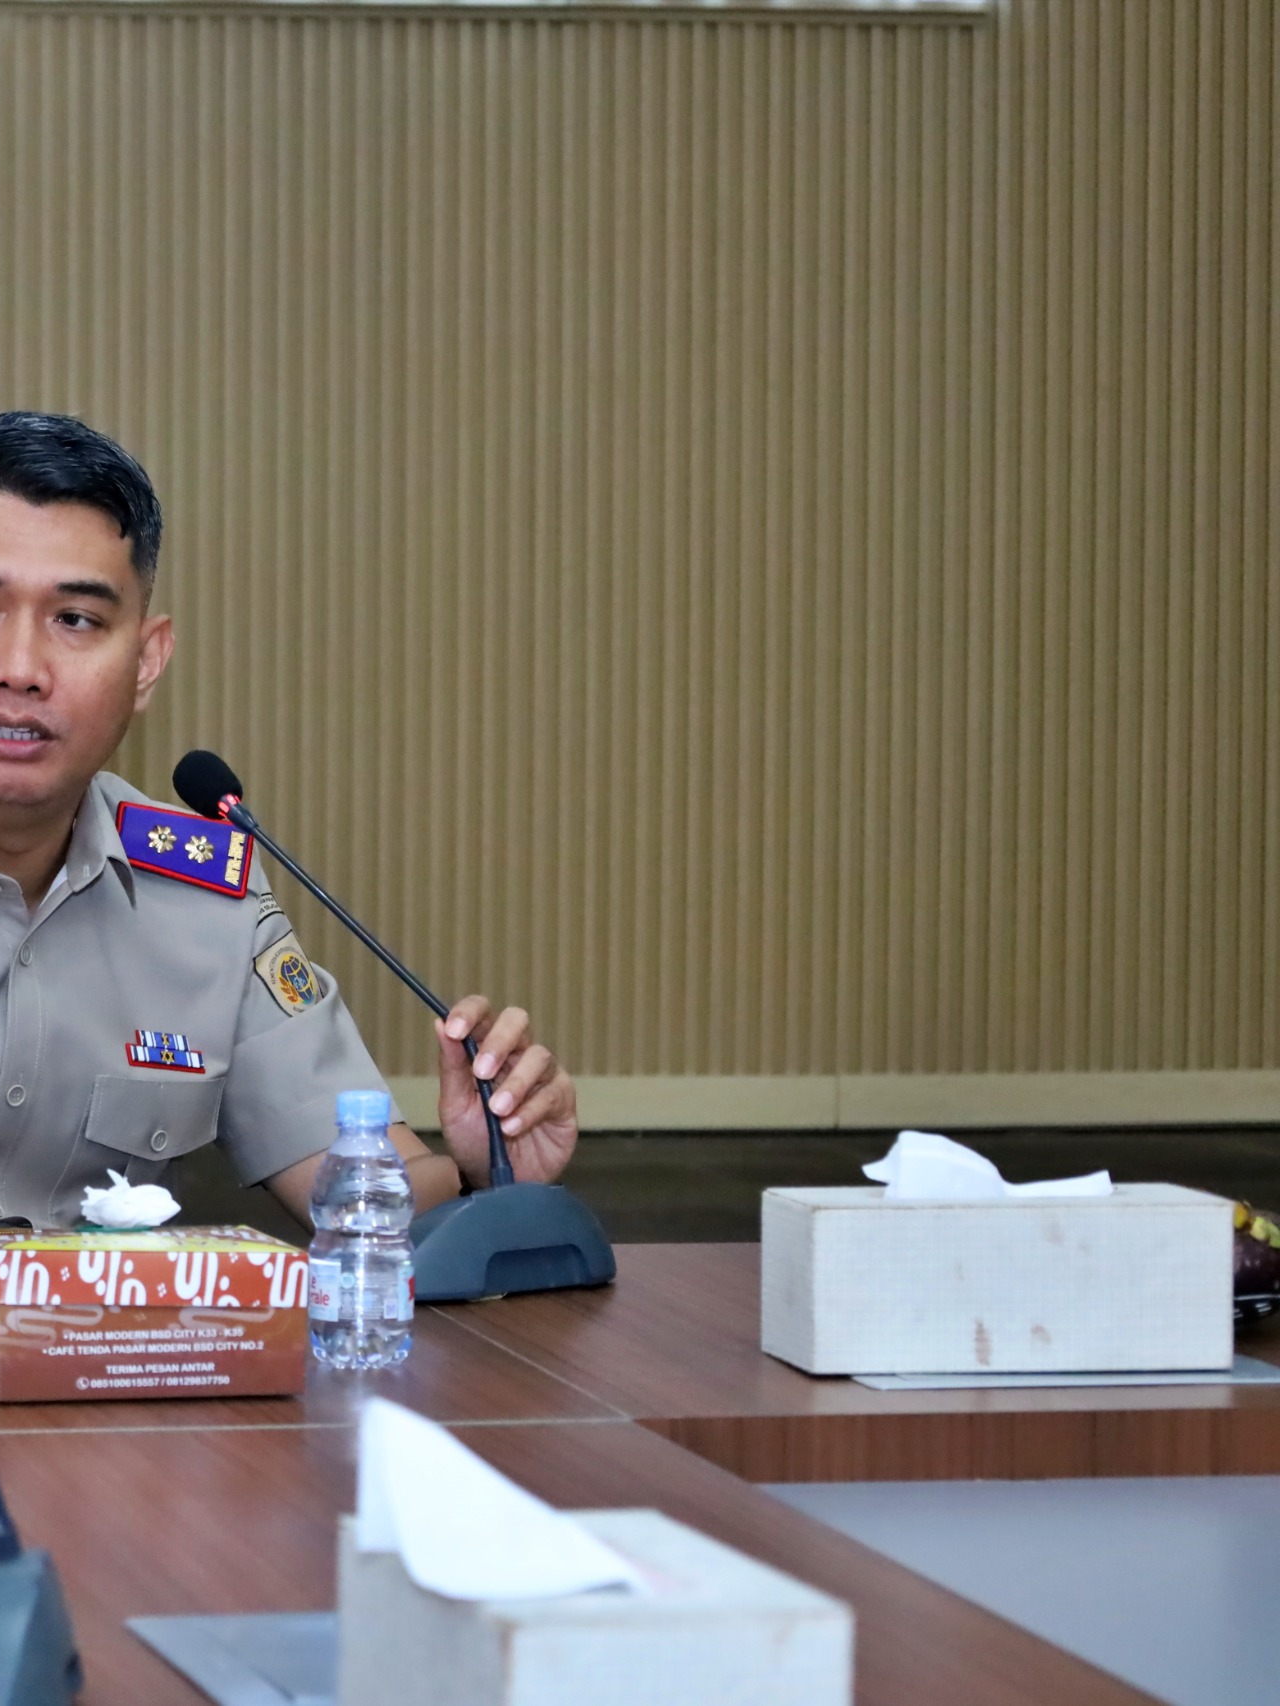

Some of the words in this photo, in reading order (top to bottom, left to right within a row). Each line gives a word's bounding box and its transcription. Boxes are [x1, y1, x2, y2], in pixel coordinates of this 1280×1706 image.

[69, 1331, 103, 1341] PASAR
[105, 1330, 149, 1340] MODERN
[151, 1329, 172, 1339] BSD
[173, 1329, 196, 1338] CITY
[77, 1345, 111, 1355] TENDA
[112, 1344, 146, 1354] PASAR
[147, 1343, 192, 1353] MODERN
[193, 1342, 214, 1352] BSD
[216, 1341, 239, 1351] CITY
[240, 1340, 264, 1351] NO.2
[106, 1364, 144, 1375] TERIMA
[145, 1363, 179, 1373] PESAN
[181, 1362, 215, 1372] ANTAR
